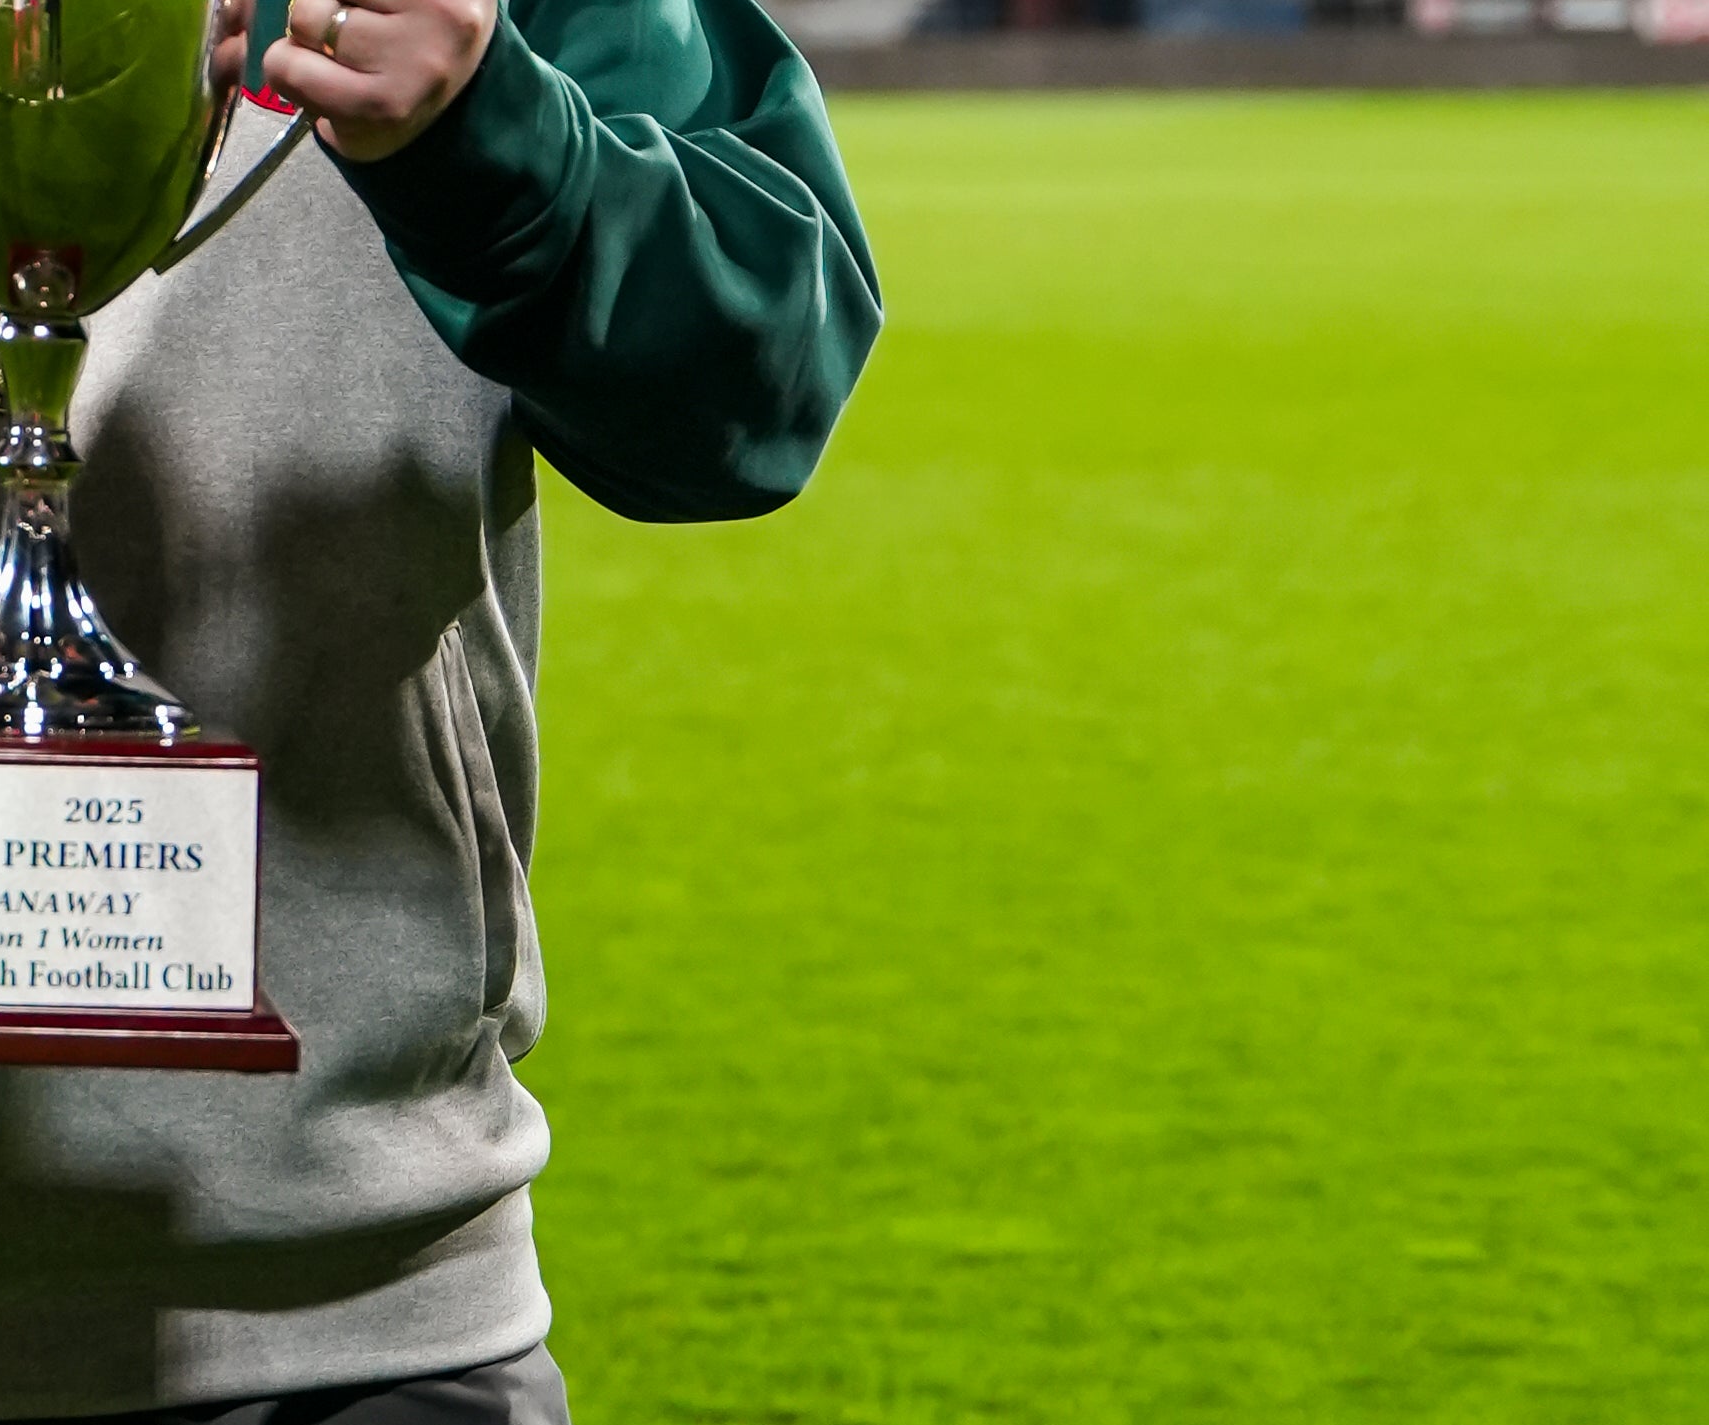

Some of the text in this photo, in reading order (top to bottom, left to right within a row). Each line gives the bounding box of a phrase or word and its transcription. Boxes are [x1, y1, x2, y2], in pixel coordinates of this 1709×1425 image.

[64, 797, 145, 824] 2025
[3, 839, 203, 871] PREMIERS
[61, 926, 164, 951] Women
[29, 960, 151, 990] Football
[162, 963, 233, 992] Club
